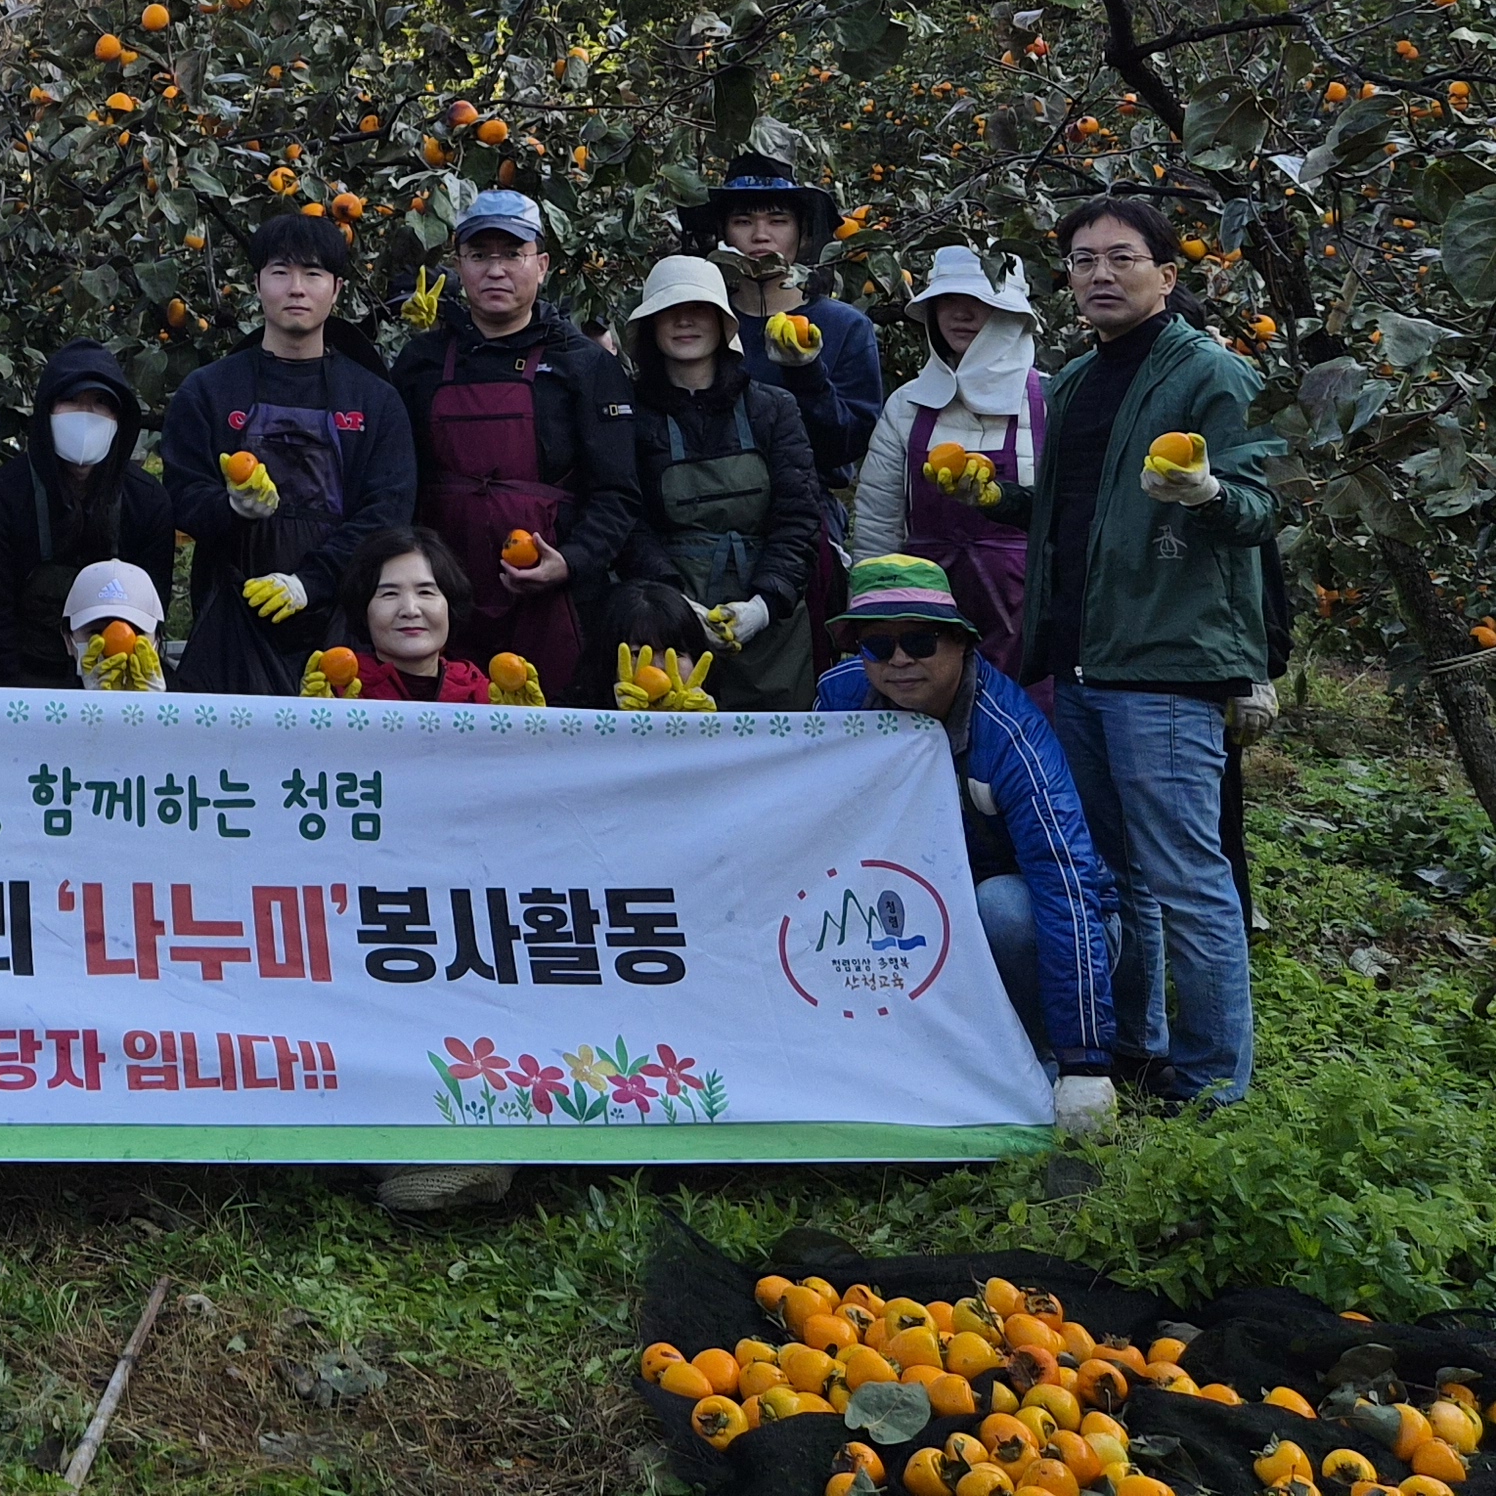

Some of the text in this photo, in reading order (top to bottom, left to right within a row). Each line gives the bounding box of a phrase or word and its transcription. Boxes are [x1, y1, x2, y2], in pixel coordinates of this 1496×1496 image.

[98, 591, 128, 600] adidas
[30, 763, 256, 839] 함께하는
[282, 768, 384, 842] 청렴
[831, 958, 871, 972] 청렴일상
[845, 973, 904, 991] 산청교육
[123, 1030, 337, 1091] 입니다!!
